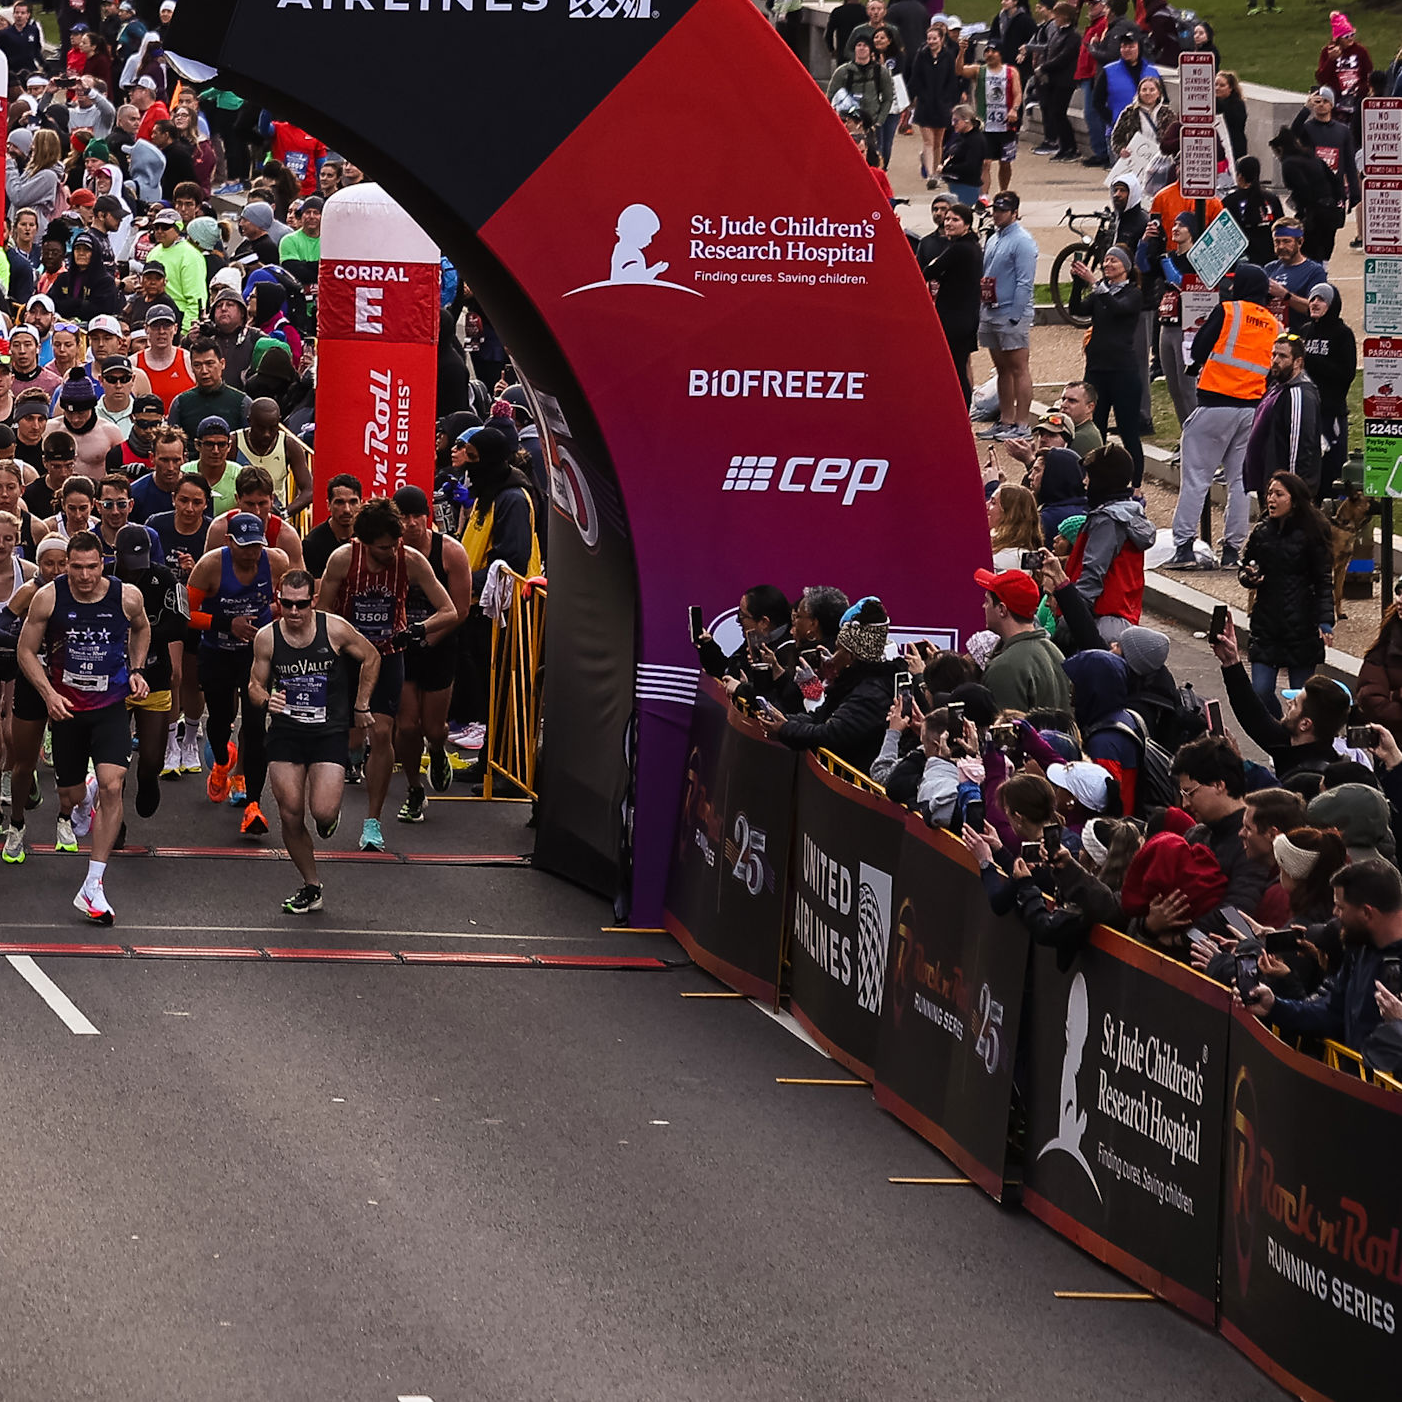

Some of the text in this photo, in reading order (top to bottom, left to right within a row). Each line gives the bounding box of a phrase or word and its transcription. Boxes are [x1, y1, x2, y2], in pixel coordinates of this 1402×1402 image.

[988, 111, 1005, 124] 43
[1369, 123, 1399, 131] STANDING
[1378, 112, 1389, 121] NO
[691, 215, 876, 239] St. Jude Children's
[689, 239, 874, 267] Research Hospital
[334, 265, 409, 283] CORRAL
[695, 271, 869, 285] Finding cures. Saving children.
[355, 287, 384, 335] E
[1368, 349, 1402, 357] PARKING
[1380, 341, 1392, 349] NO
[395, 385, 411, 455] SERIES
[779, 456, 890, 506] cep
[355, 612, 389, 622] 13508
[80, 662, 94, 671] 48
[295, 693, 310, 701] 42
[803, 832, 852, 916] UNITED
[794, 891, 852, 986] AIRLINES
[914, 992, 965, 1042] RUNNING SERIES
[1101, 1012, 1204, 1107] St. Jude Children's
[1097, 1068, 1201, 1166] Research Hospital
[1097, 1141, 1122, 1180] Finding
[1142, 1166, 1165, 1206] Saving
[1260, 1147, 1317, 1243] Rock
[1267, 1235, 1396, 1335] RUNNING SERIES
